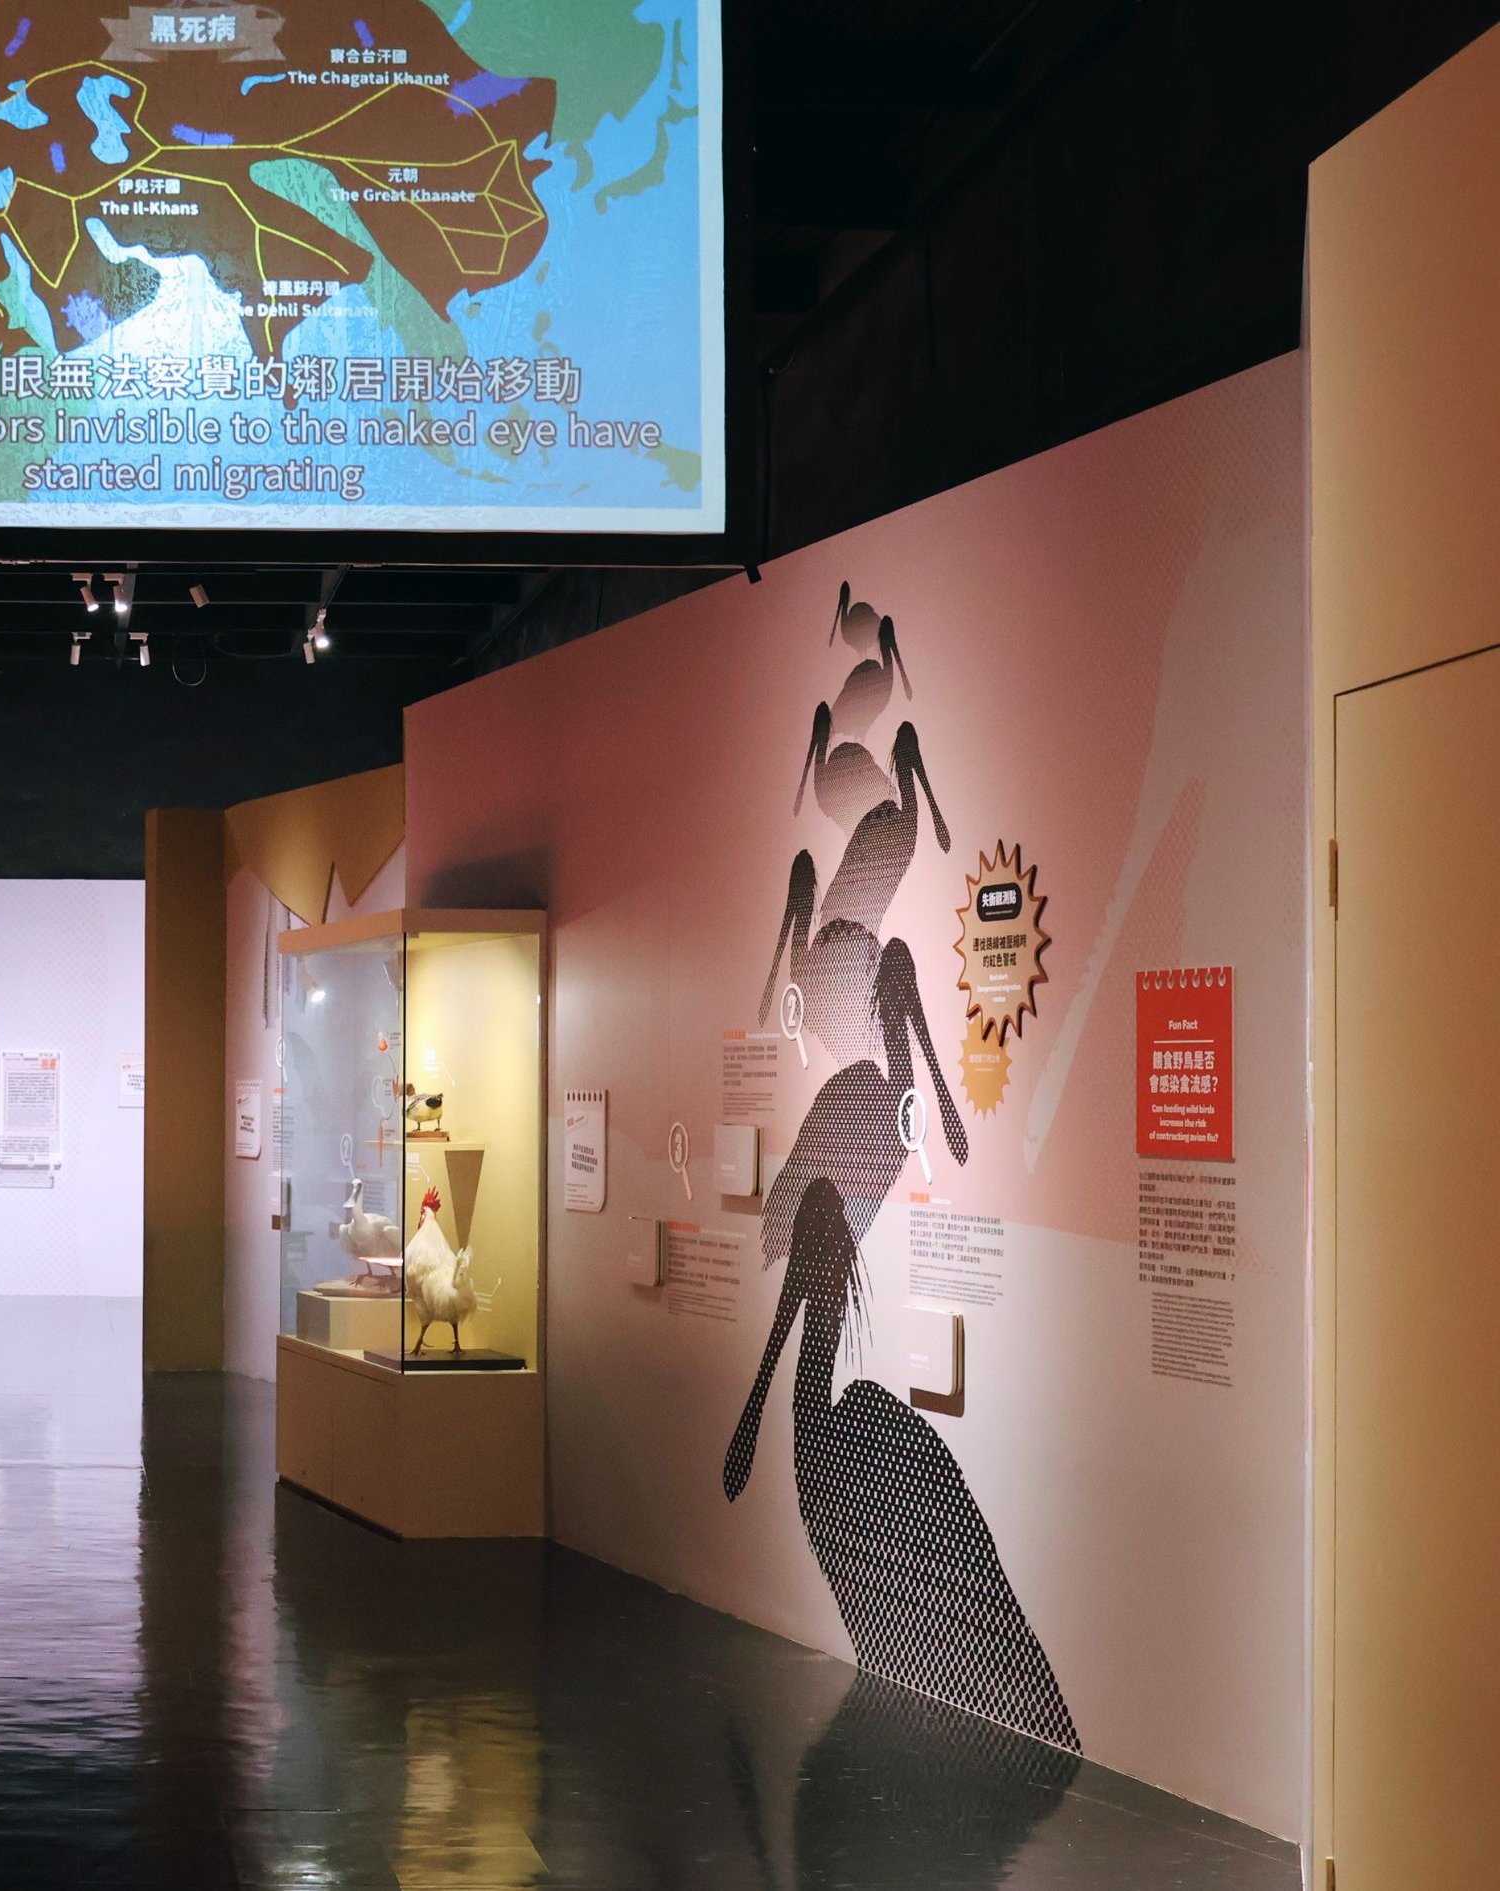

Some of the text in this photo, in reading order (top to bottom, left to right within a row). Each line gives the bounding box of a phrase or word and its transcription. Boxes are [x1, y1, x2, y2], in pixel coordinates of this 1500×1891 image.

[151, 14, 237, 43] 黑死病
[330, 48, 408, 64] 察合台汗國
[287, 71, 450, 88] The Chagatai Khanat
[388, 168, 419, 183] 元朝
[118, 178, 181, 195] 伊兒汗國
[330, 188, 477, 203] The Great Khanate
[100, 200, 199, 215] The Il-Khans
[257, 302, 299, 317] Dehli
[56, 407, 220, 445] invisible
[231, 413, 272, 445] to
[283, 408, 348, 445] the
[358, 410, 478, 447] naked
[488, 417, 557, 456] eye
[567, 411, 662, 448] have
[22, 455, 366, 501] started migrating
[787, 993, 796, 1027] 2
[1168, 1019, 1198, 1030] Fun Fact
[1152, 1051, 1215, 1070] 餵食野鳥是否
[1151, 1104, 1215, 1116] Can feeding wild birds
[907, 1103, 915, 1139] 1
[1159, 1117, 1207, 1129] increase the risk
[1149, 1130, 1219, 1144] of contracting avian flu?
